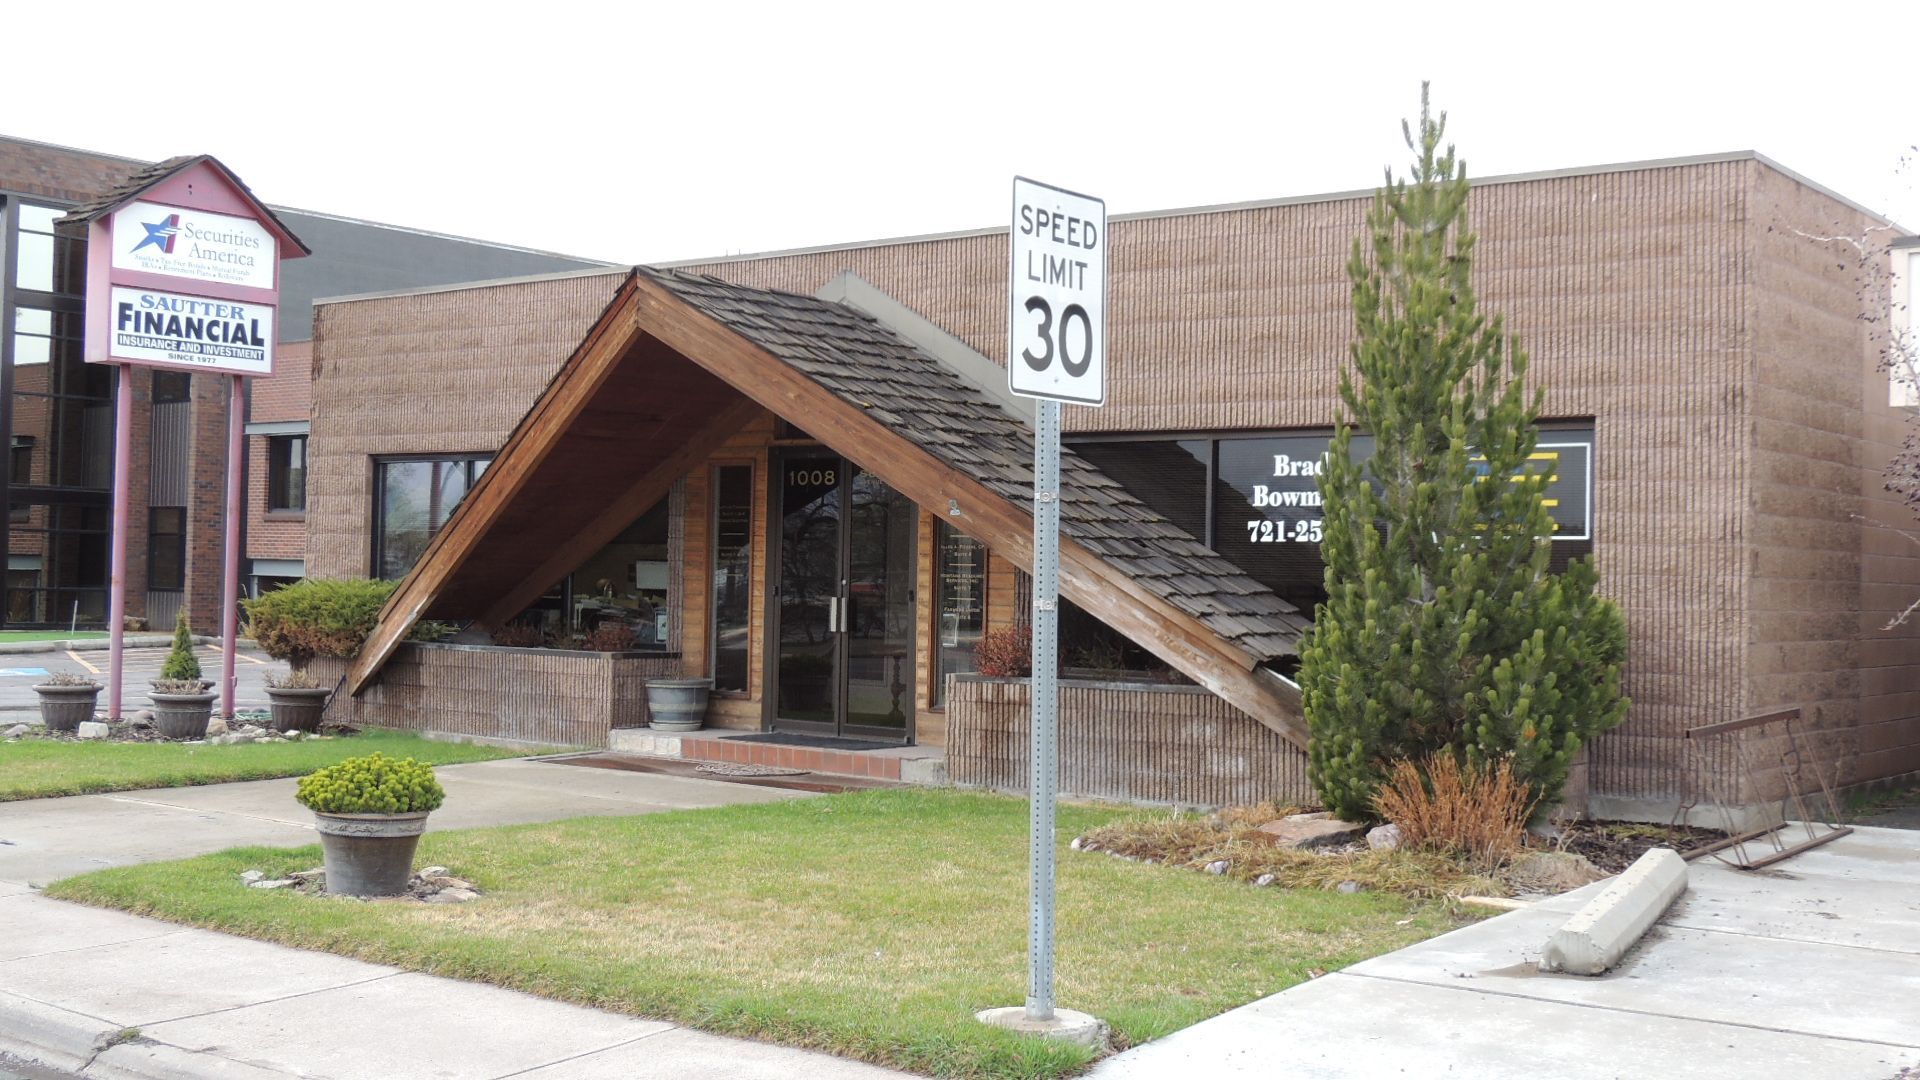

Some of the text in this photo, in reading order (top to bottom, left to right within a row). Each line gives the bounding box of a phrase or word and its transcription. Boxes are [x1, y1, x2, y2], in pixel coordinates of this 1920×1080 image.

[184, 222, 260, 249] Securities
[1020, 204, 1097, 250] SPEED
[188, 245, 255, 267] America
[1028, 250, 1088, 291] LIMIT
[140, 294, 245, 320] SAUTTER
[118, 302, 265, 347] FINANCIAL
[1022, 295, 1093, 378] 30
[119, 335, 263, 361] INSURANCE AND INVESTMENT
[168, 353, 217, 364] SINCE 1977
[789, 470, 835, 486] 1008
[1252, 485, 1322, 507] Bowm
[1247, 520, 1323, 543] 721-25
